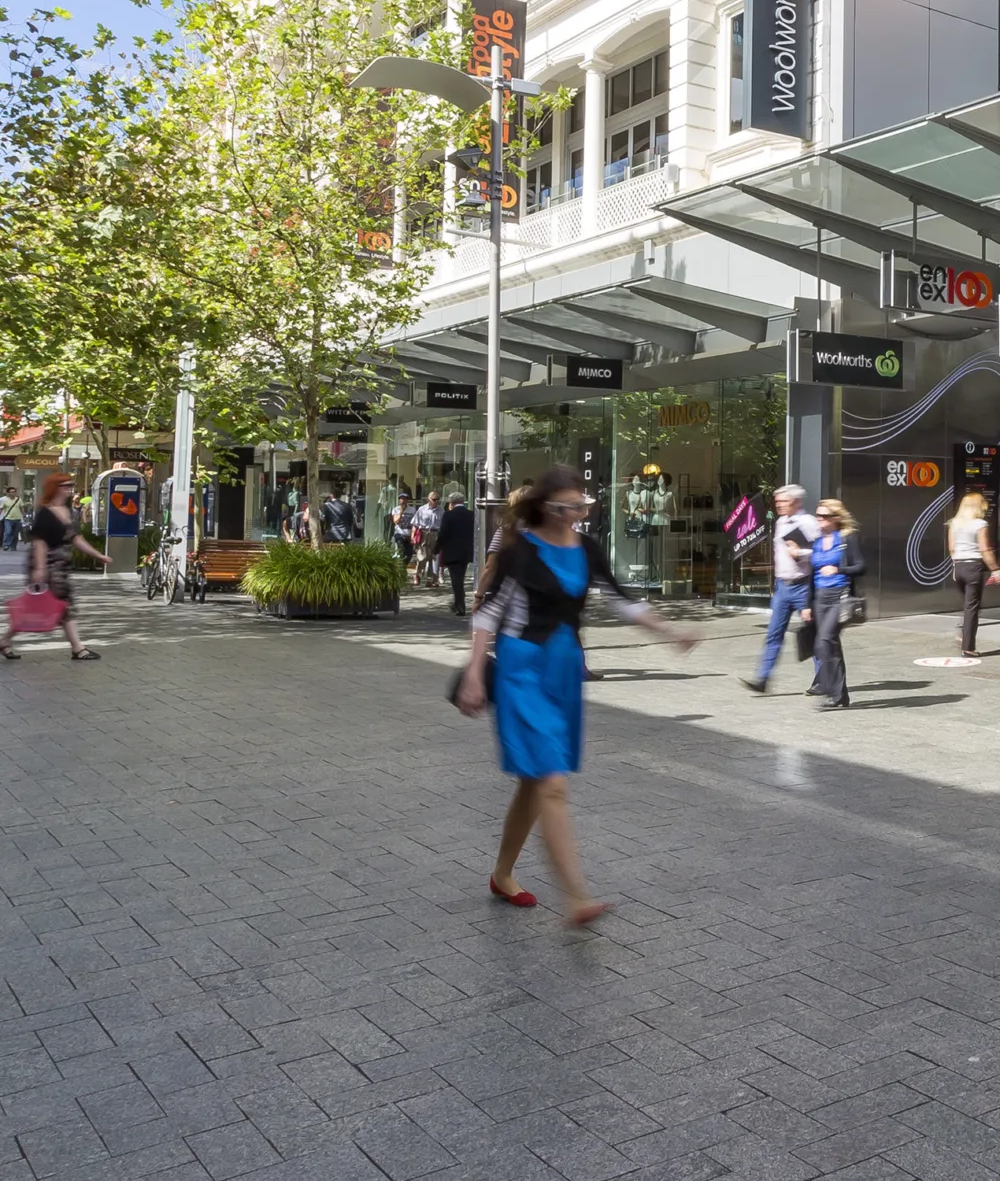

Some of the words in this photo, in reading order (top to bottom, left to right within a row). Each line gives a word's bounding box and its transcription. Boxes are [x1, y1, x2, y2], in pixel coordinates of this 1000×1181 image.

[920, 263, 947, 284] en
[920, 282, 947, 301] ex
[816, 351, 873, 369] Woolworths
[578, 367, 612, 379] MIMCO
[434, 392, 470, 400] POLITIX
[658, 401, 711, 428] MIMCO
[887, 460, 907, 473] en
[887, 473, 907, 486] ex
[736, 505, 758, 539] sale
[733, 542, 741, 552] UP
[740, 539, 747, 548] TO
[755, 524, 765, 536] OFF
